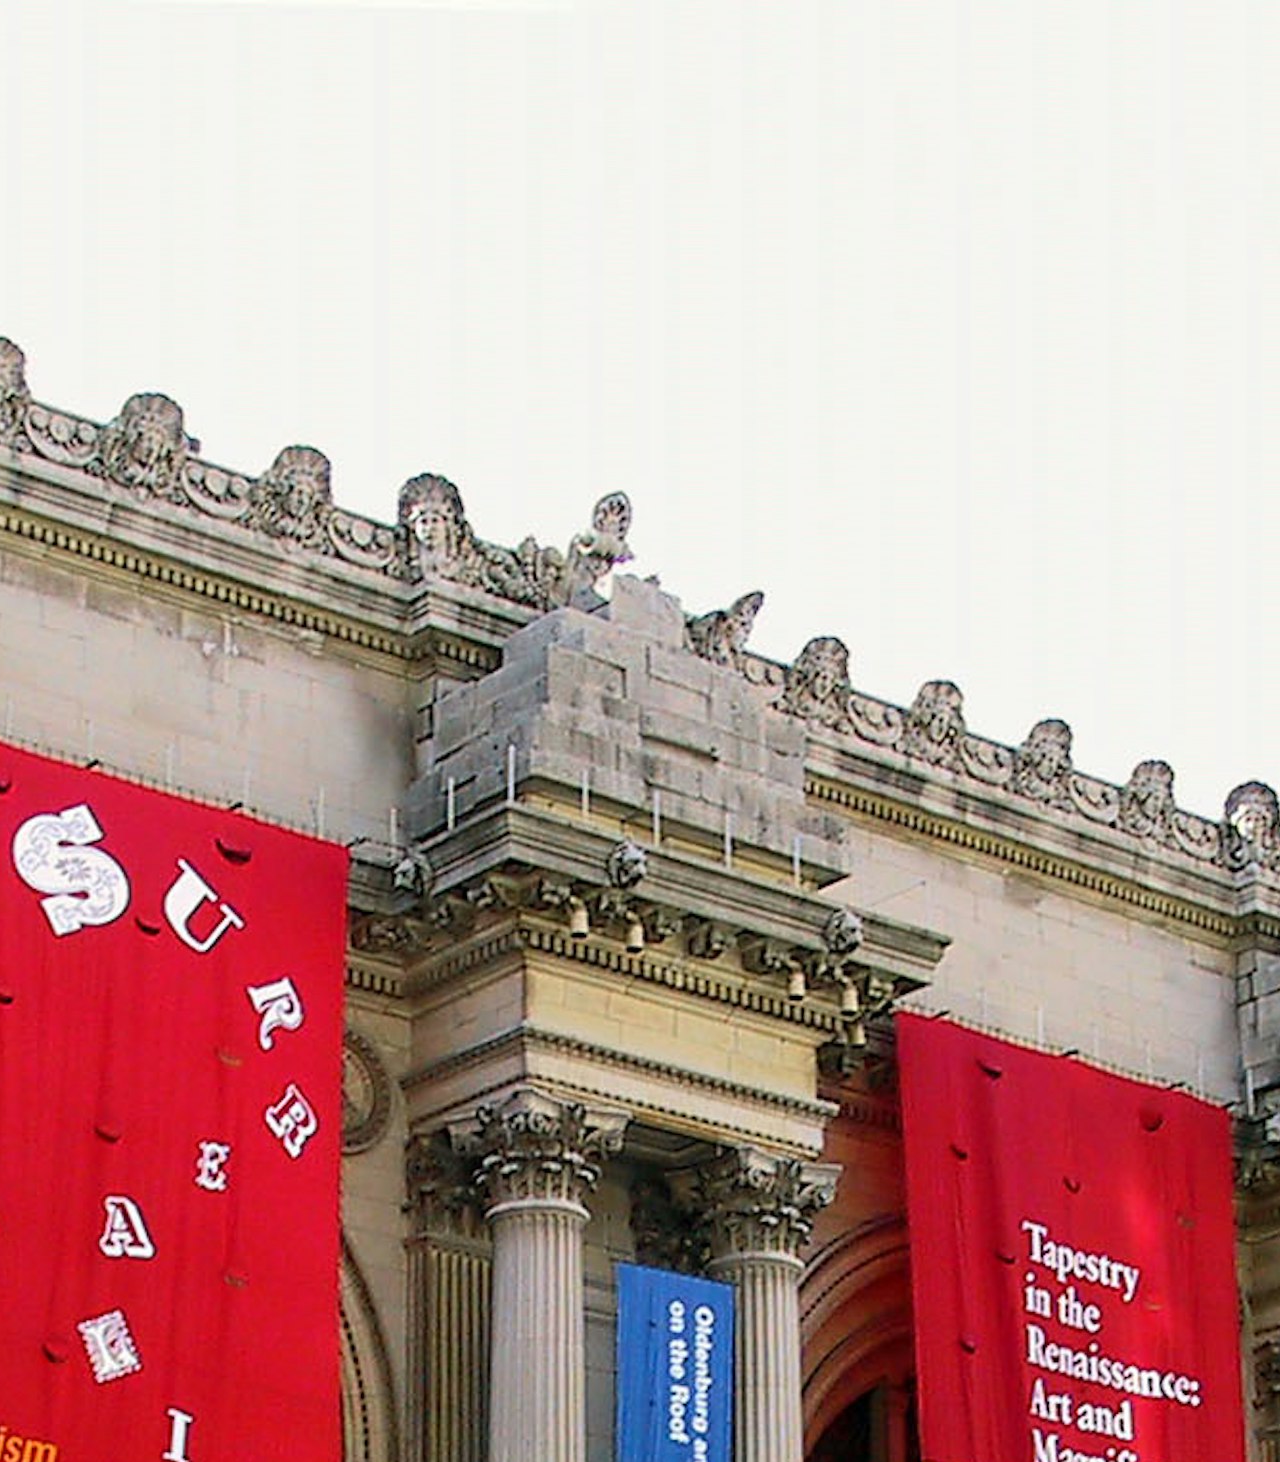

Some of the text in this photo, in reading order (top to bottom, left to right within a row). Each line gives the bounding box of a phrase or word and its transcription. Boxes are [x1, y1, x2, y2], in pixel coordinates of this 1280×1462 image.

[1022, 1220, 1139, 1302] Tapestry
[1025, 1272, 1100, 1333] in the
[669, 1300, 691, 1445] on the Roof
[691, 1305, 715, 1433] Oldenburg
[1026, 1324, 1201, 1406] Renaissance:
[1030, 1378, 1133, 1440] Art and
